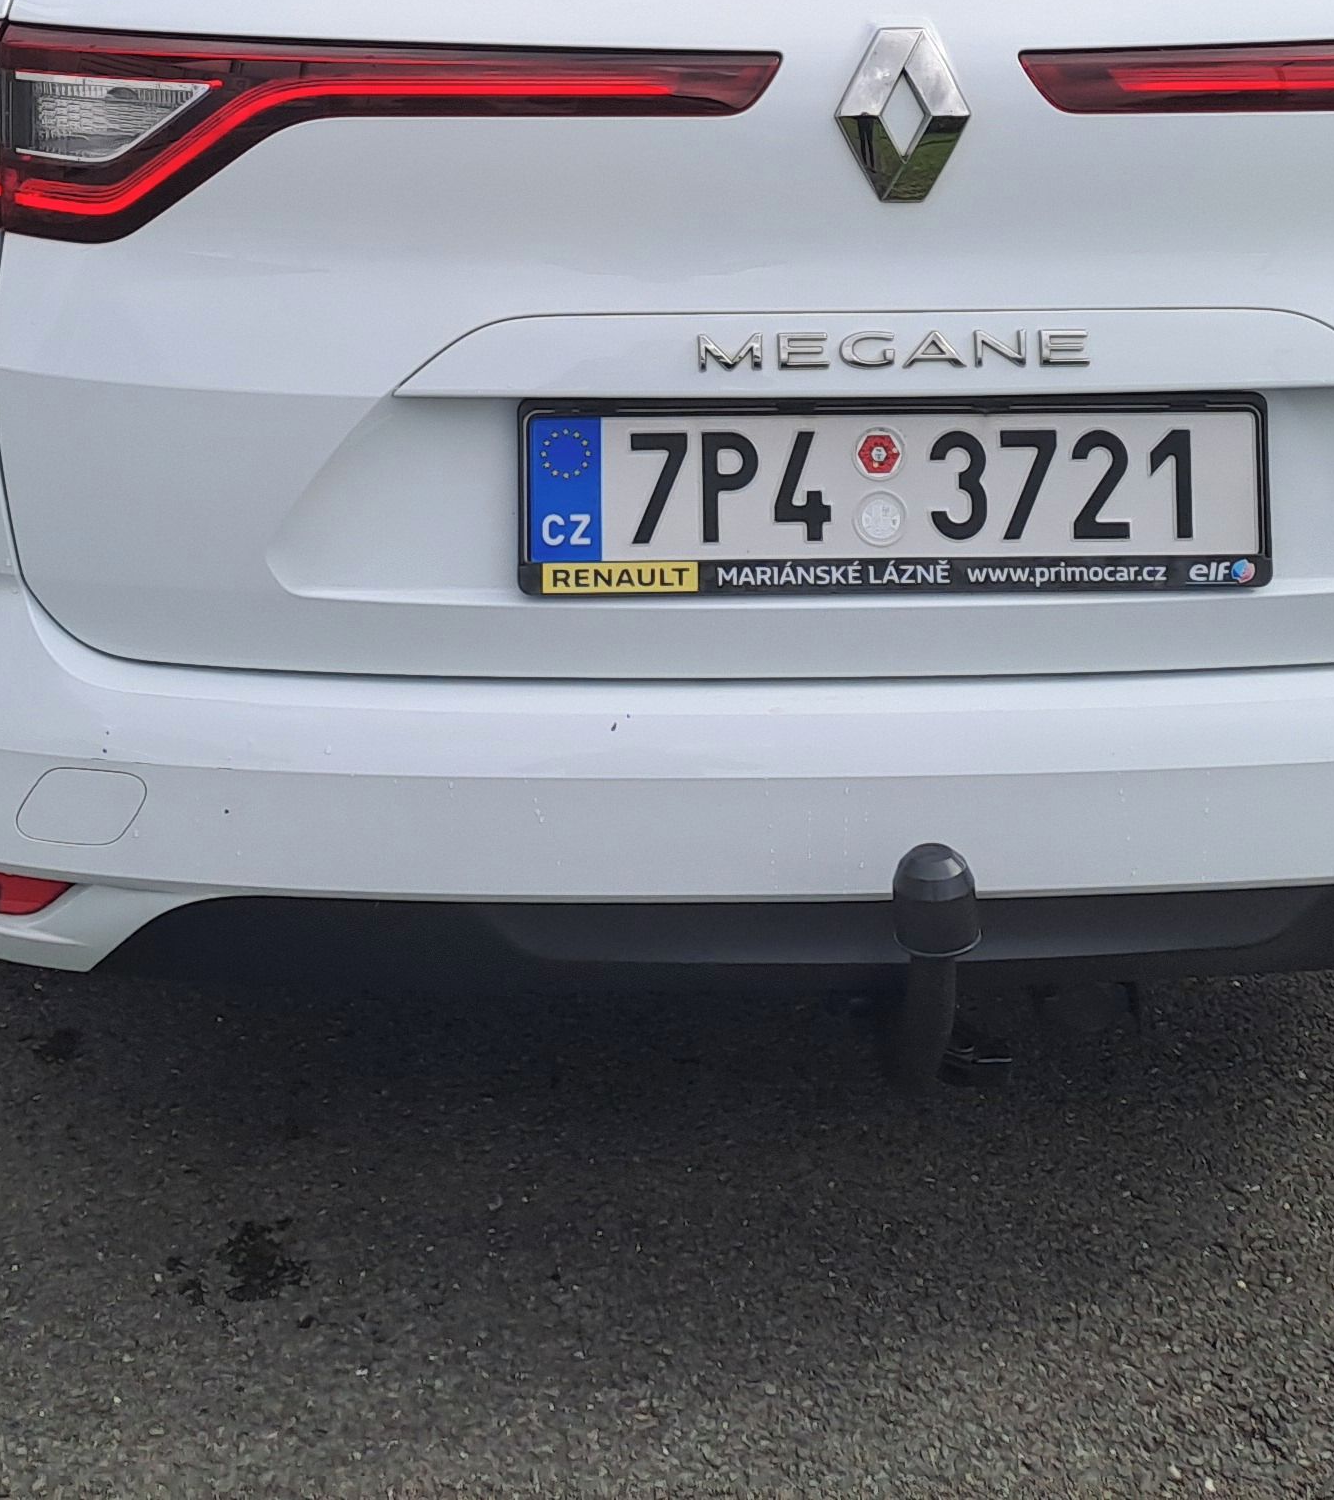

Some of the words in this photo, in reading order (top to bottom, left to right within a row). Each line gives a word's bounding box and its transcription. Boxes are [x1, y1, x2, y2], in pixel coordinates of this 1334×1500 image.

[697, 329, 1091, 372] MEGANE
[630, 431, 832, 544] 7P4
[929, 429, 1194, 541] 3721
[542, 514, 592, 546] CZ
[552, 567, 690, 588] RENAULT
[717, 561, 862, 587] MARIÁNSKÉ
[868, 560, 951, 585] LÁZNĚ
[967, 562, 1167, 587] www.primocar.cz
[1188, 562, 1230, 583] elf
